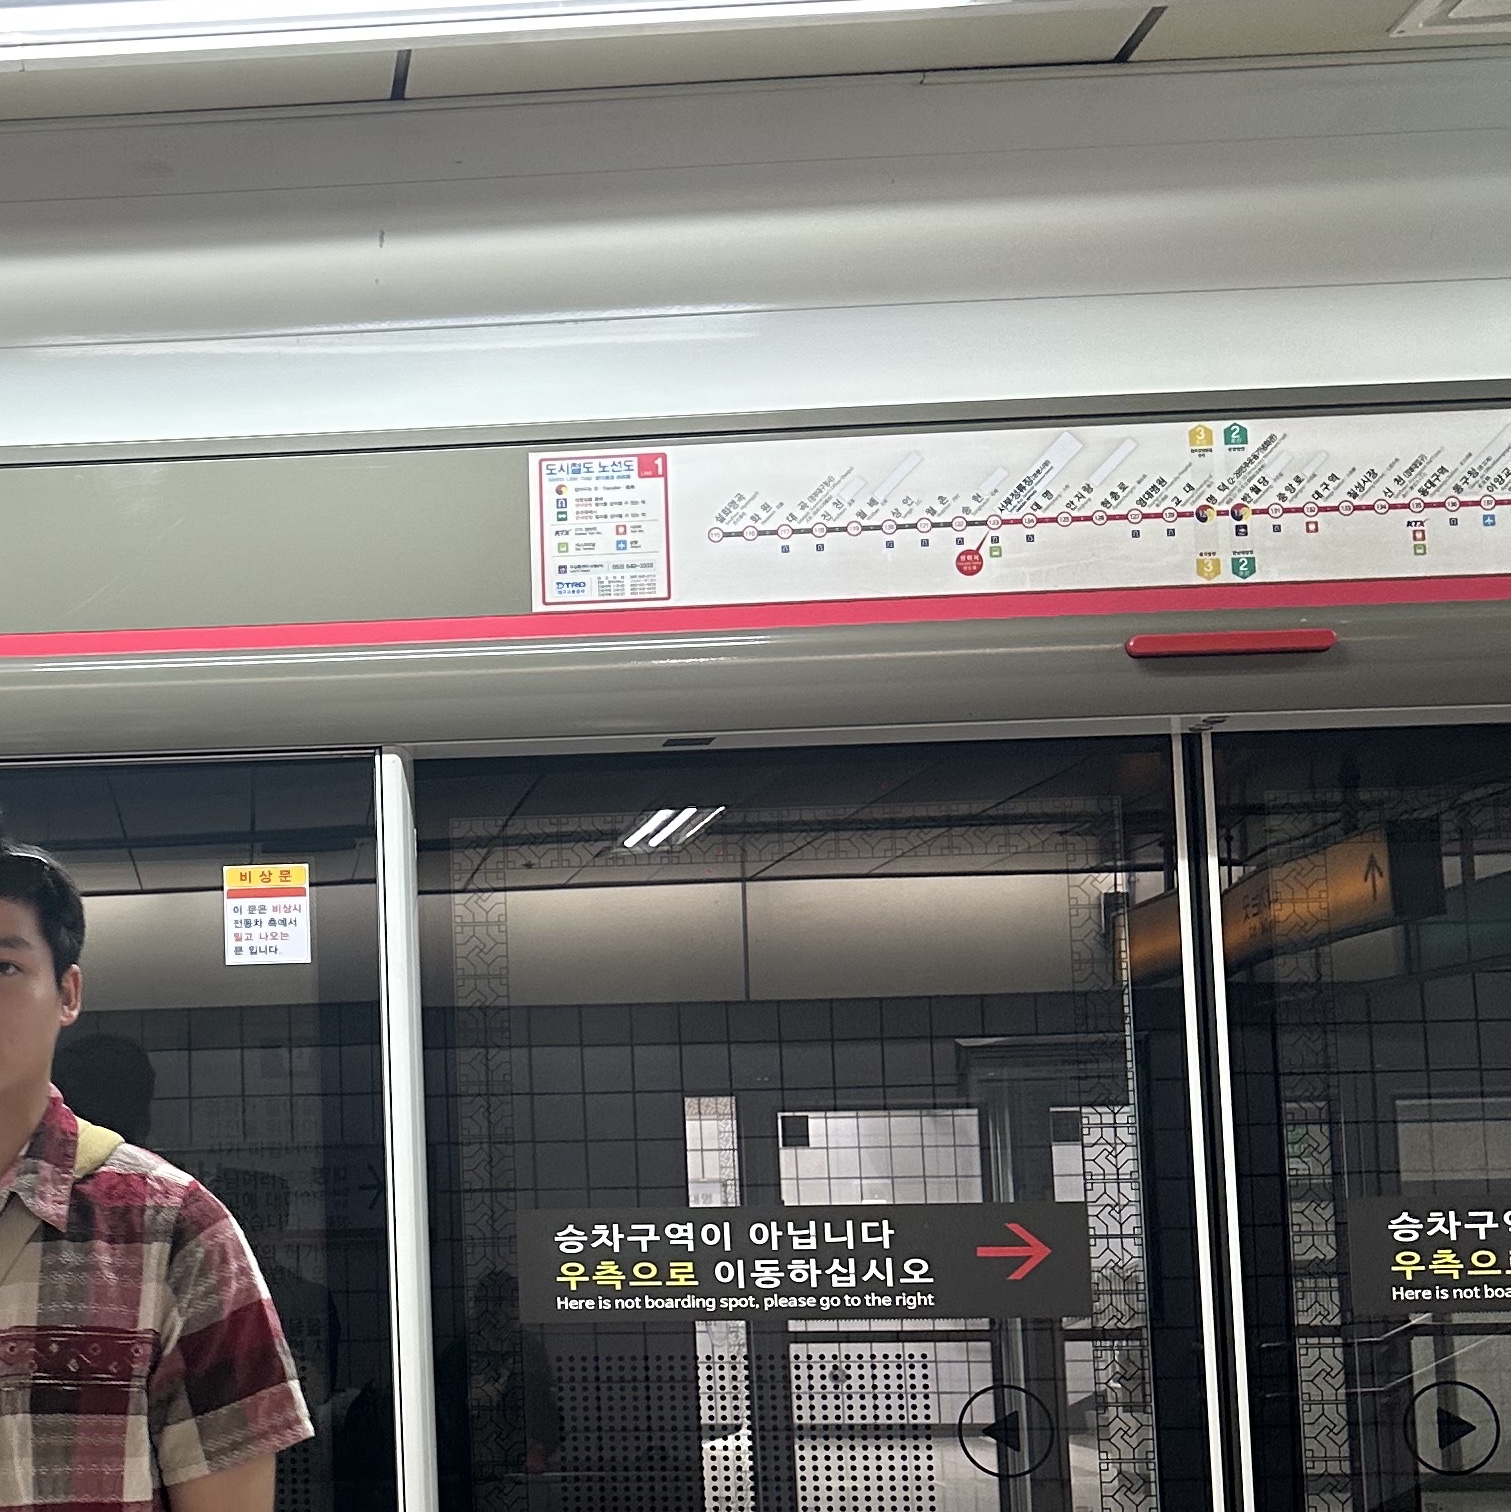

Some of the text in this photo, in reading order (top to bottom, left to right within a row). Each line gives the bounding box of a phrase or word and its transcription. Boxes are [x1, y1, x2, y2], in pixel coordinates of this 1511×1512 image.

[545, 459, 635, 475] 도시철도 노선도
[654, 457, 663, 476] 1
[239, 870, 292, 883] 비상문
[1388, 1211, 1511, 1241] 승차구
[555, 1220, 894, 1253] 승차구역이 아닙니다
[557, 1258, 933, 1290] 우측으로 이동하십시오
[1391, 1250, 1511, 1280] 우측으
[557, 1292, 934, 1311] Here is not boarding spot, please go to the right
[1392, 1287, 1431, 1300] Here
[1436, 1286, 1449, 1299] is
[1453, 1287, 1480, 1298] not
